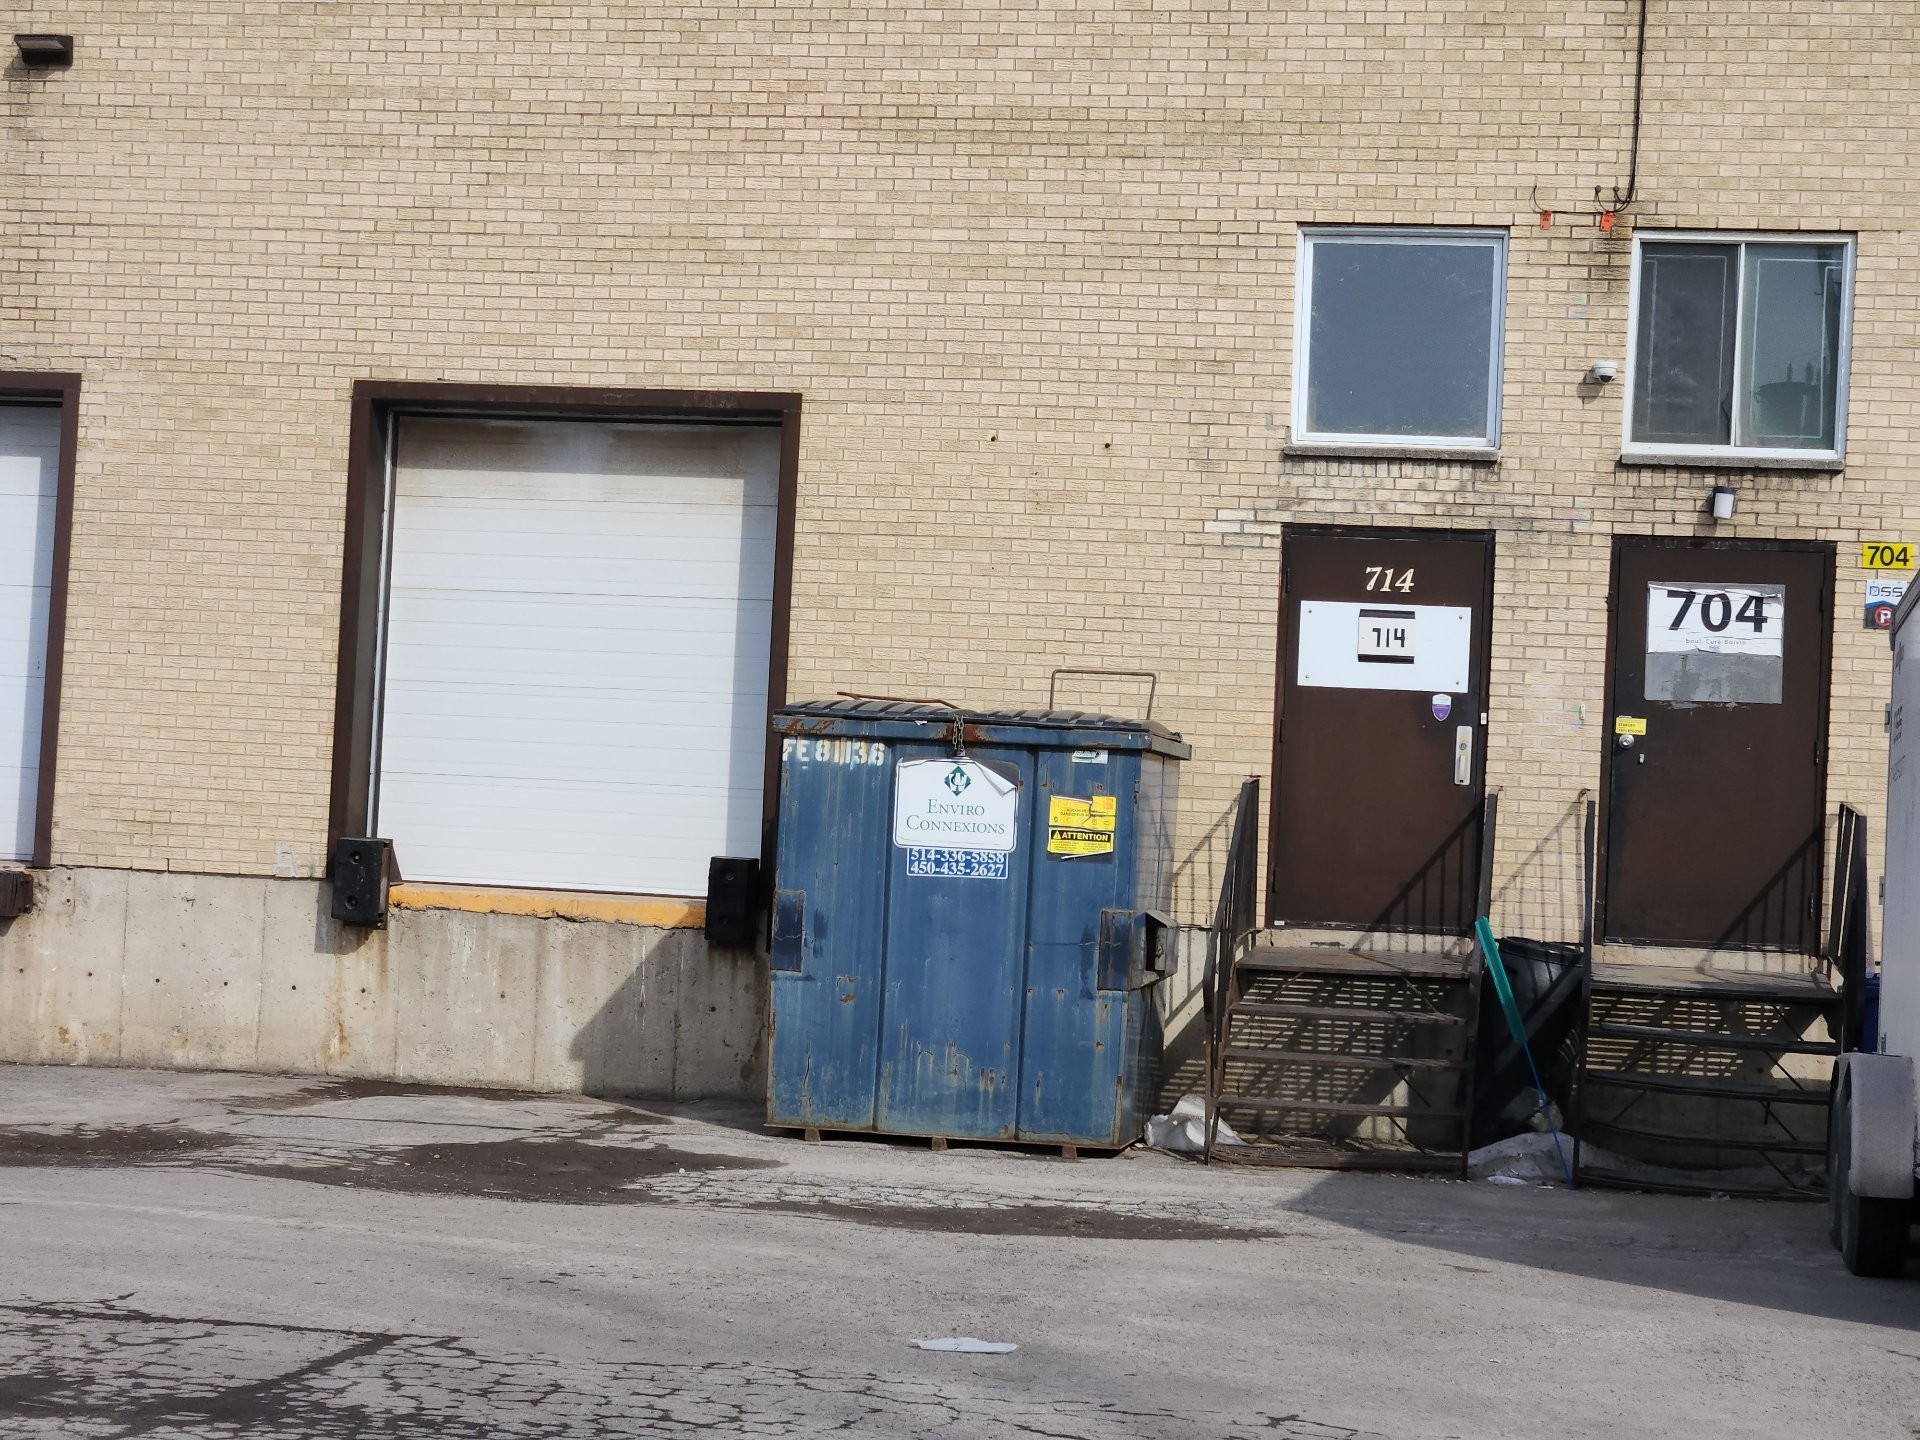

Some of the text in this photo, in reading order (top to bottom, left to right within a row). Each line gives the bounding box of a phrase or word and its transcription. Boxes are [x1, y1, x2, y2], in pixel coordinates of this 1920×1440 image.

[1867, 545, 1910, 567] 704
[1365, 566, 1415, 593] 714
[1666, 589, 1768, 633] 704
[1372, 627, 1406, 648] 714
[1061, 831, 1109, 842] ATTENTION
[911, 847, 1005, 863] 514-336-5858
[910, 861, 1005, 877] 450-435-2627
